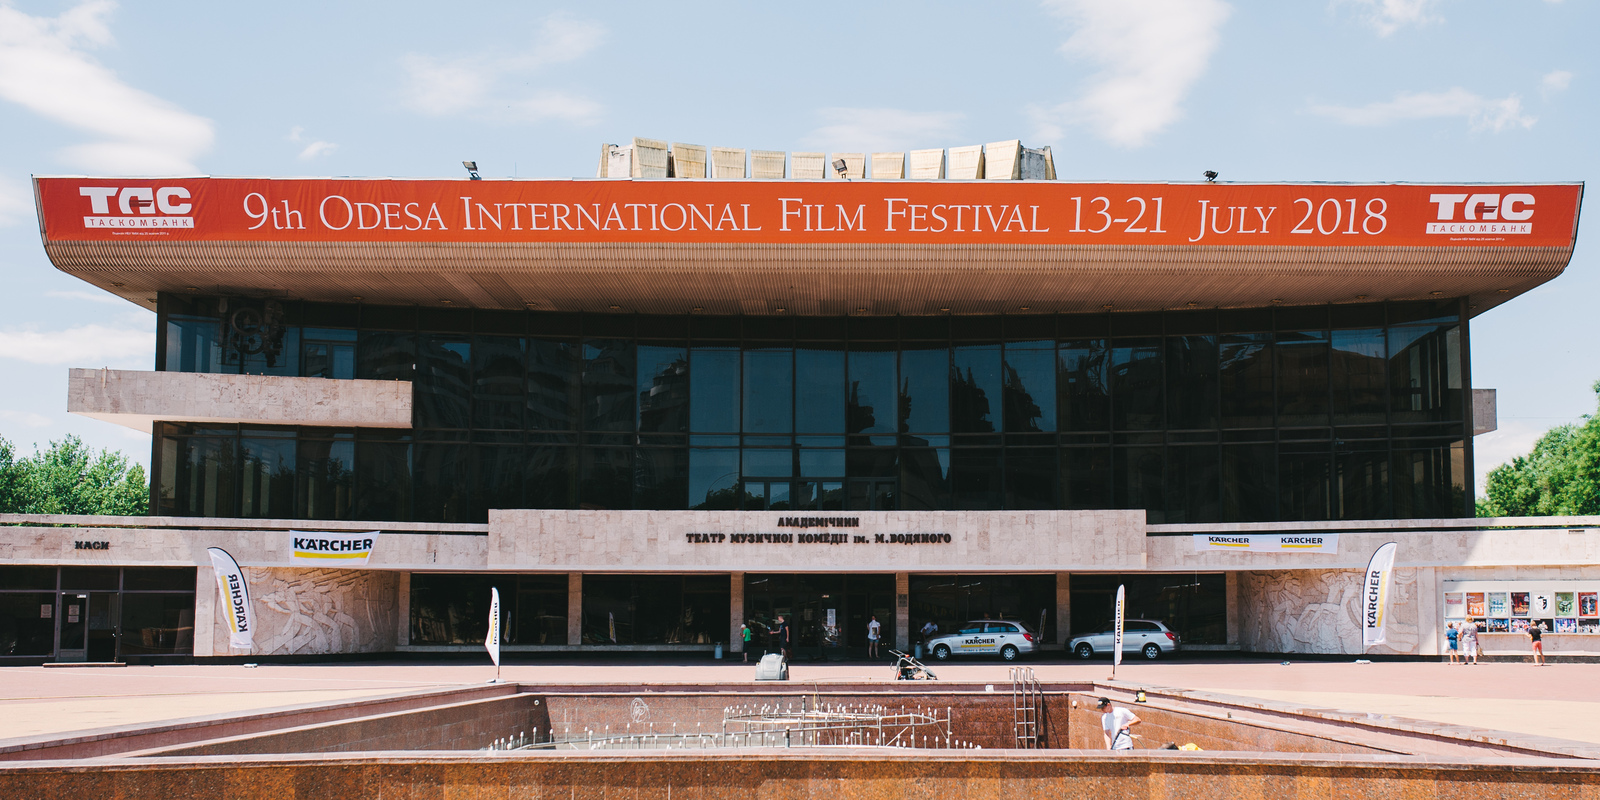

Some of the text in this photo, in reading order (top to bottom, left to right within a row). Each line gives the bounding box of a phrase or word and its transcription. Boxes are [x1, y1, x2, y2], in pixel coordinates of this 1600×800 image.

[243, 192, 1388, 242] 9th ODESA INTERNATIONAL FILM FESTIVAL 13-21 JULY 2018
[294, 538, 373, 551] KÄRCHER
[686, 533, 726, 543] ТЕАТР
[74, 541, 109, 550] КАСИ
[1367, 570, 1380, 628] KÄRCHER
